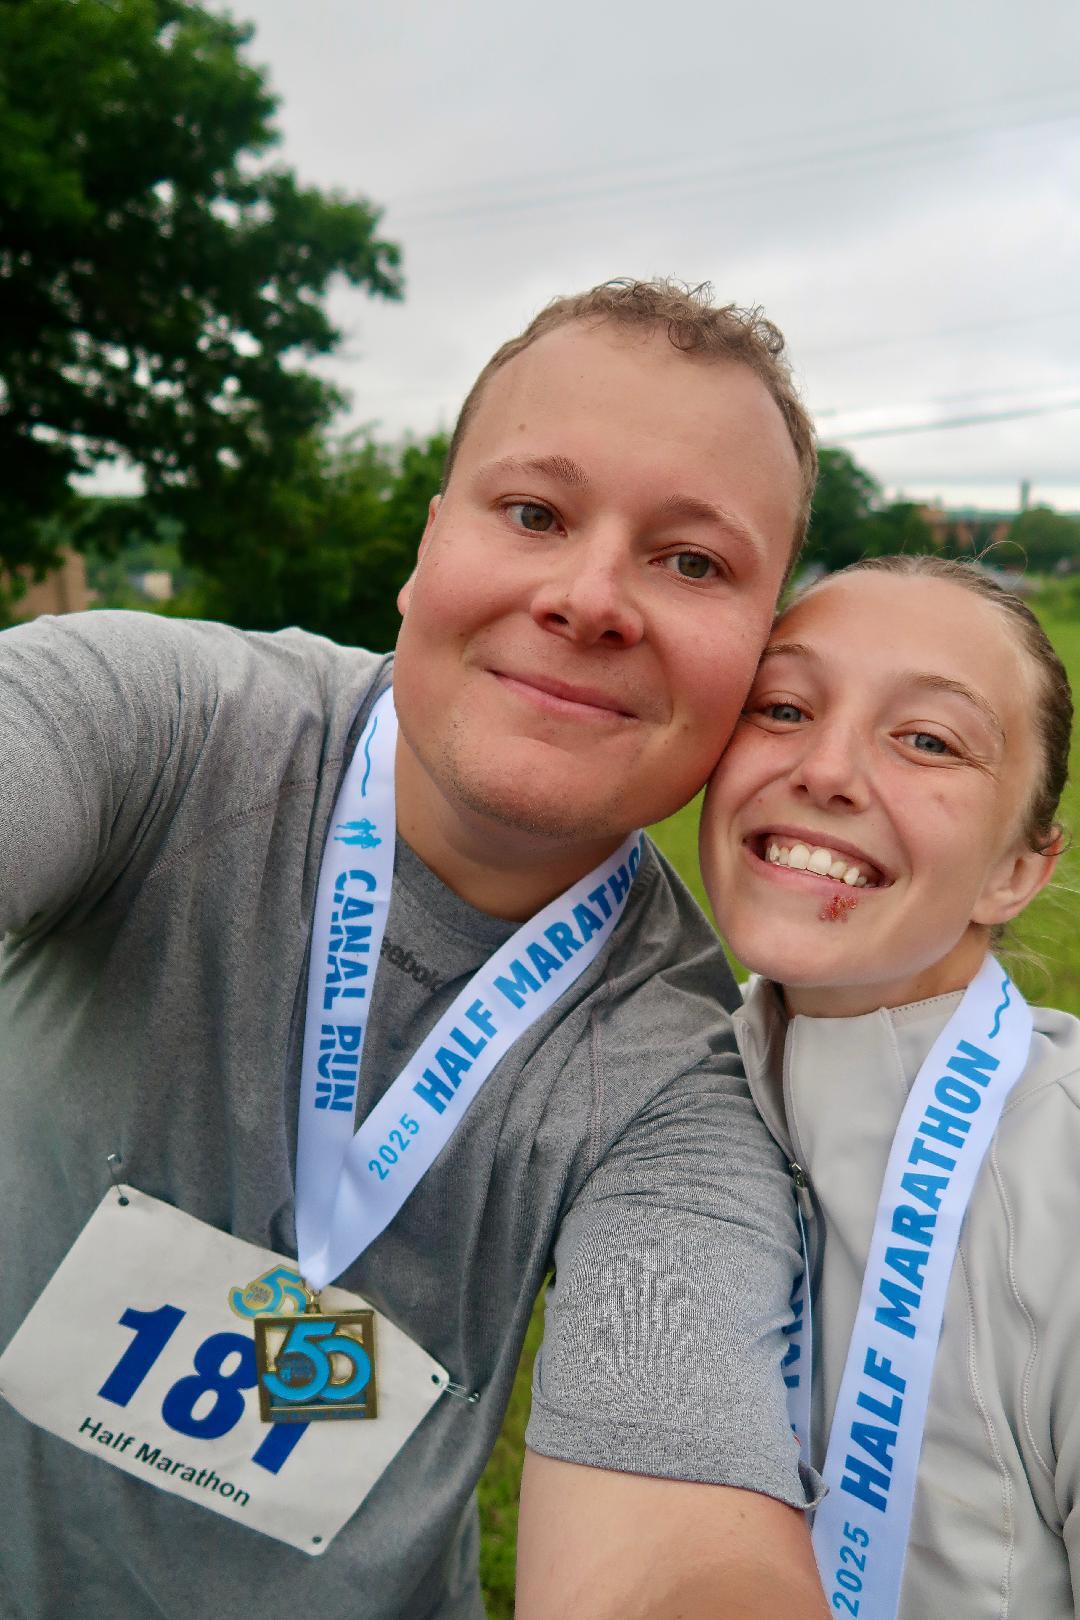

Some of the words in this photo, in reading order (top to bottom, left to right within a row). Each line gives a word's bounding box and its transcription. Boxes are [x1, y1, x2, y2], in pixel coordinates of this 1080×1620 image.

[322, 868, 378, 1011] CANAL
[367, 1113, 421, 1182] 2025
[412, 998, 498, 1116] HALF
[493, 832, 645, 1010] MARATHO
[313, 1023, 363, 1113] RUN
[873, 1038, 1001, 1340] MARATHON
[261, 1321, 372, 1402] 50
[78, 1416, 136, 1454] Half
[134, 1442, 252, 1507] Marathon
[839, 1346, 907, 1514] HALF
[831, 1519, 871, 1618] 2025
